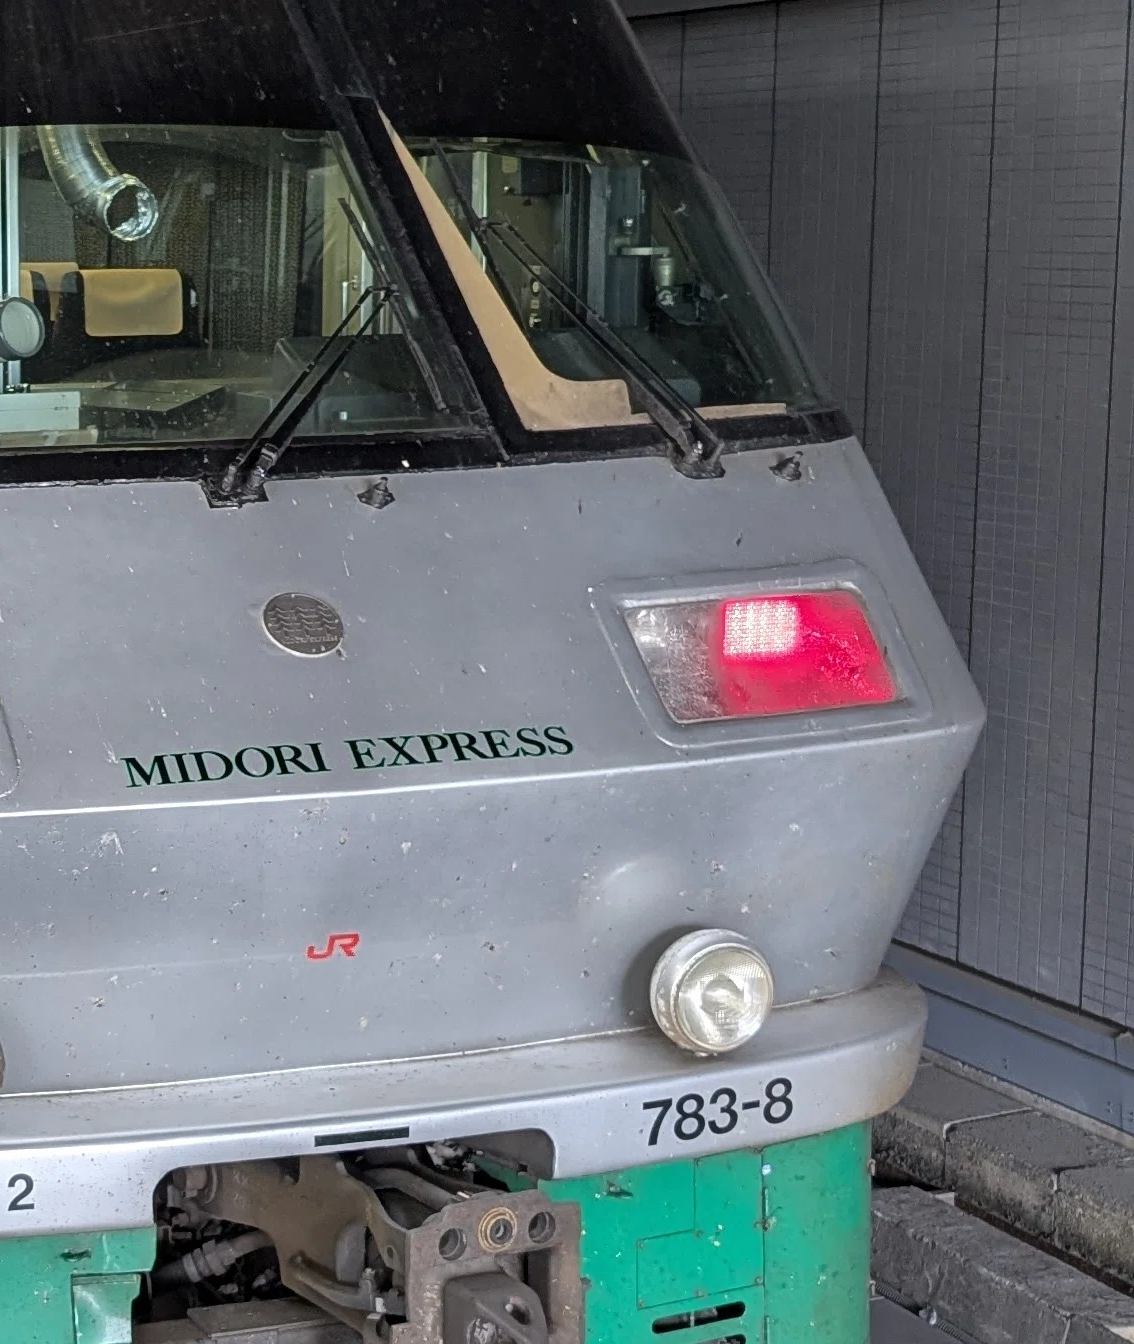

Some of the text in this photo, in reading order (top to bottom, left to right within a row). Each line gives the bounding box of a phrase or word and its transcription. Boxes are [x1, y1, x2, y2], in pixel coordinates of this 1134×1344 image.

[121, 725, 575, 789] MIDORI EXPRESS
[306, 931, 361, 961] JR
[642, 1077, 794, 1147] 783-8
